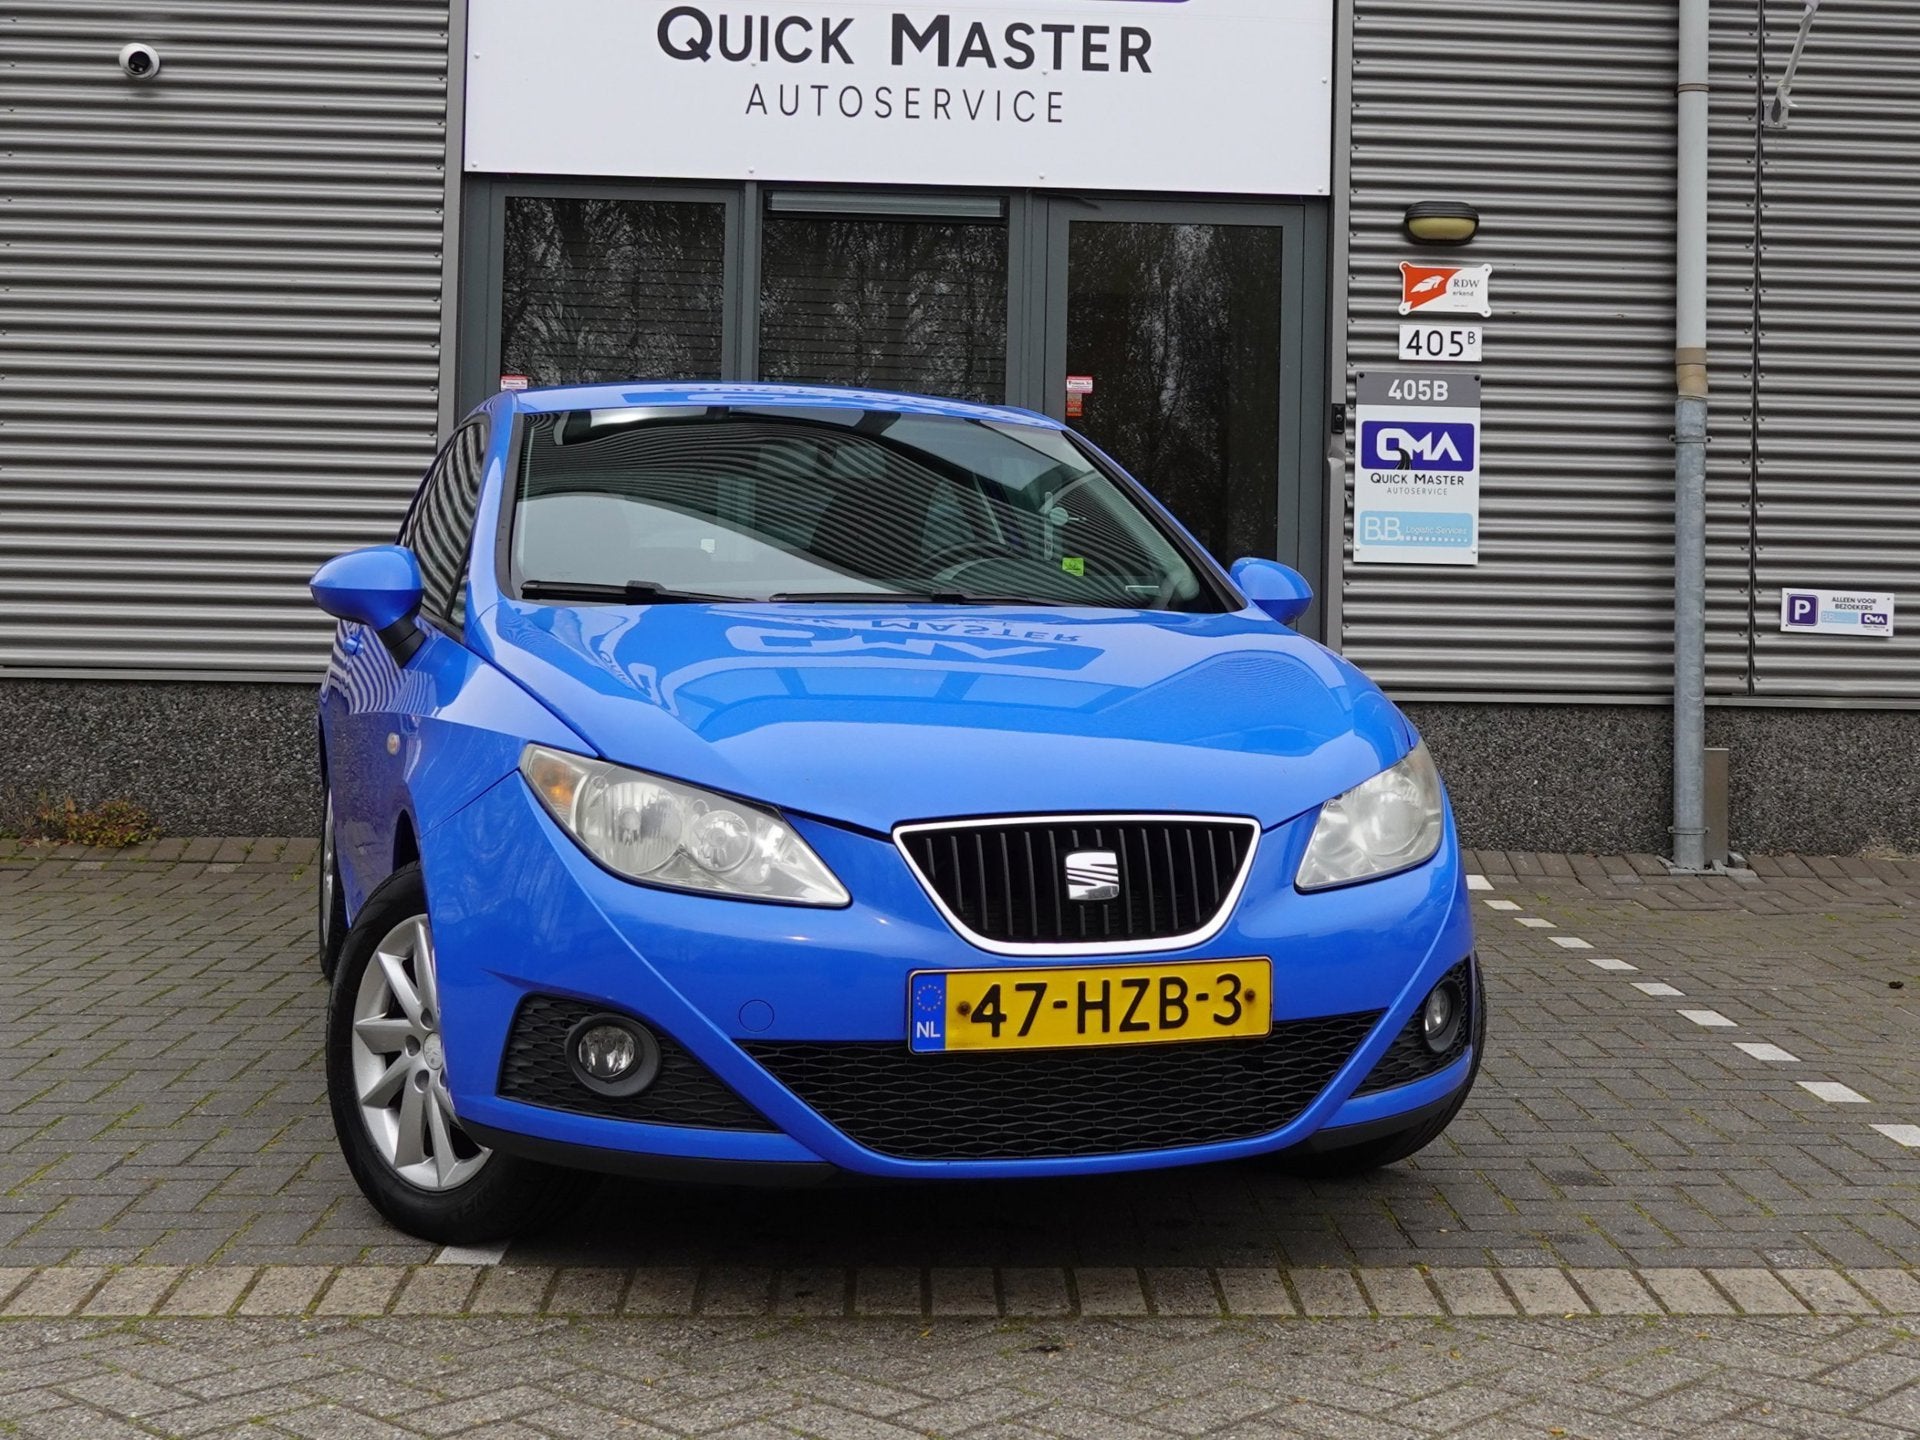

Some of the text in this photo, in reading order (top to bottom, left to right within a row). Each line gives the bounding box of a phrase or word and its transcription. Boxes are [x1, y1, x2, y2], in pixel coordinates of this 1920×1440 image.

[657, 5, 1153, 74] QUICK MASTER
[745, 83, 1064, 123] AUTOSERVICE
[1453, 278, 1480, 288] RDW
[1388, 379, 1449, 401] 405B
[1370, 472, 1464, 486] QUICK MASTER
[1387, 487, 1448, 496] AUTOSERVICE
[1832, 596, 1856, 604] ALLEEN
[1835, 603, 1873, 611] BEZOEKERS
[1794, 599, 1811, 621] P
[916, 973, 1243, 1039] NL 47-HZB-3
